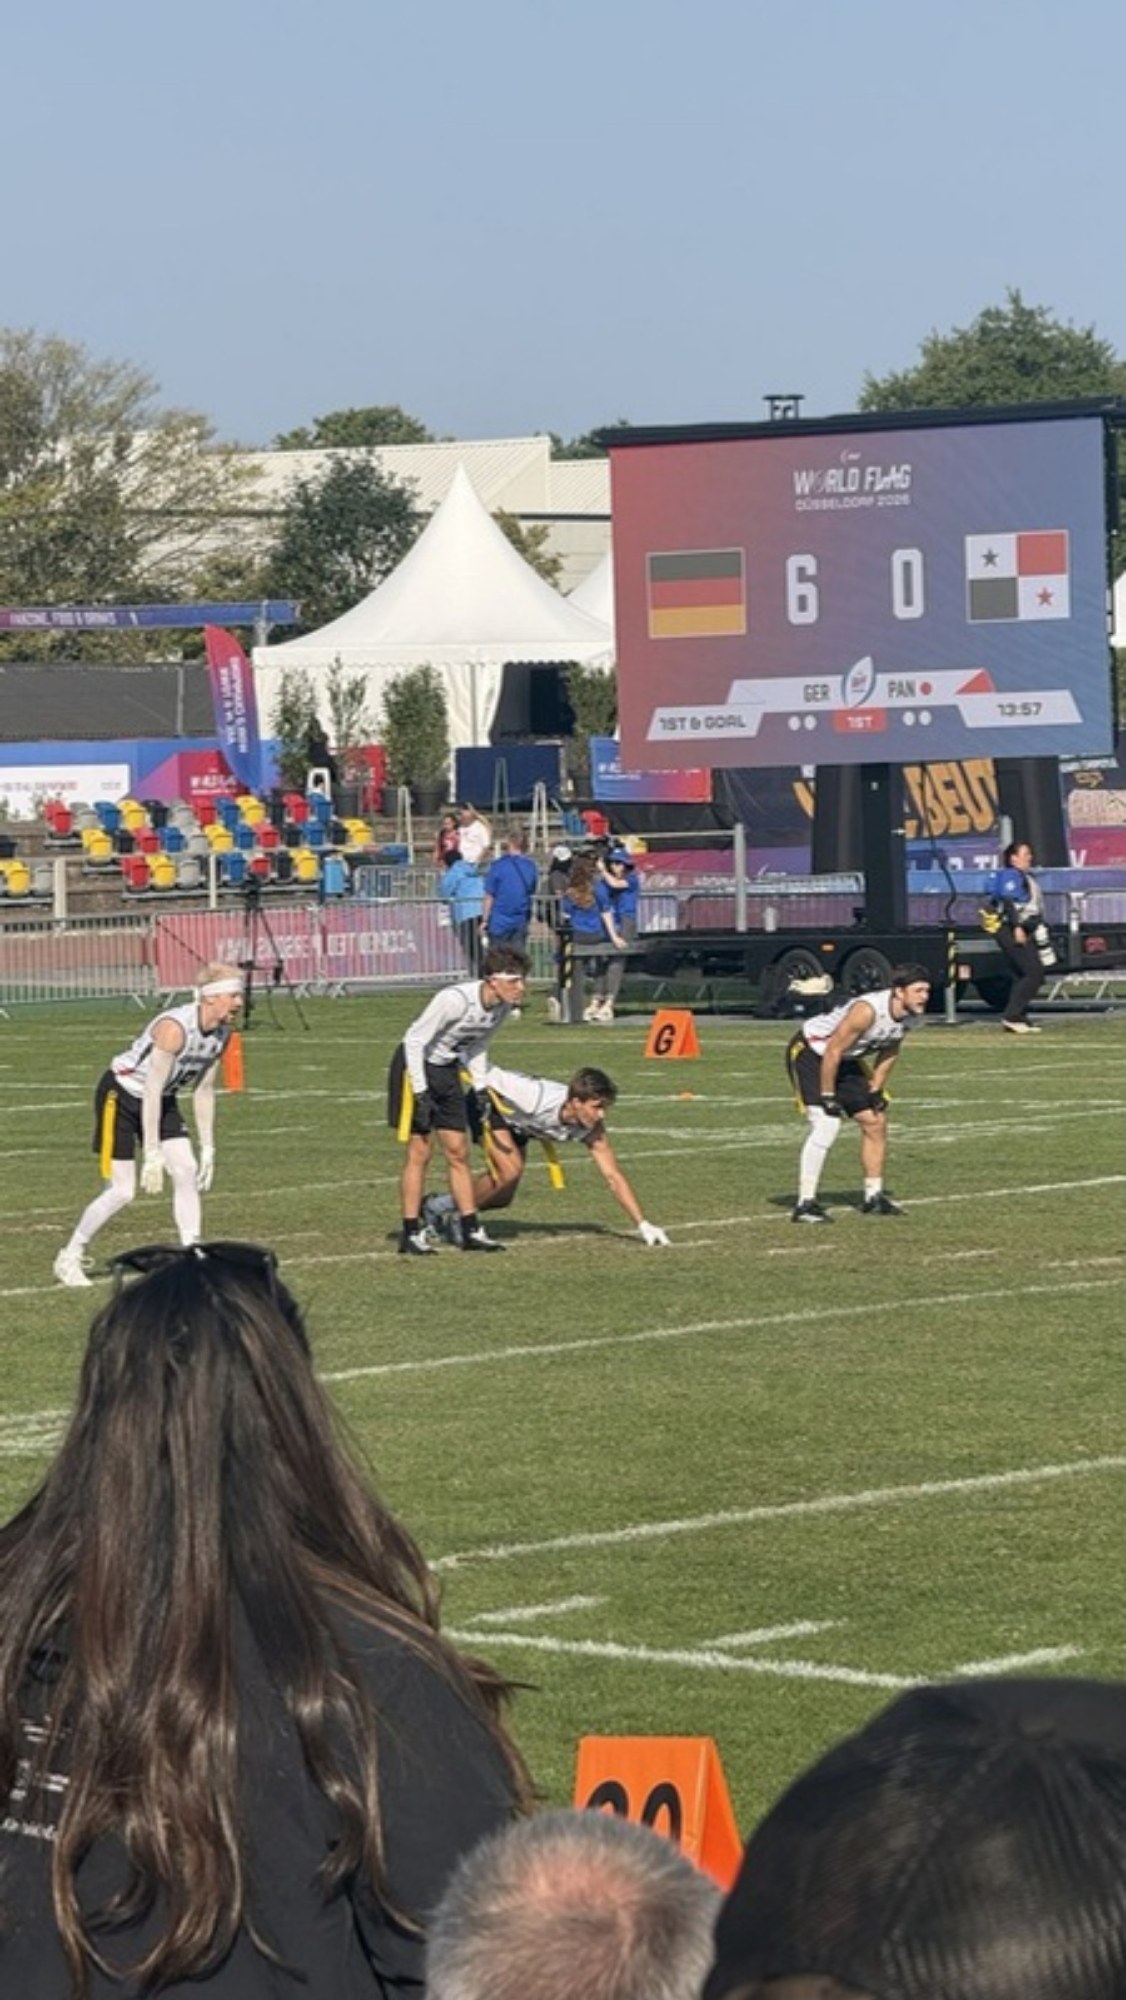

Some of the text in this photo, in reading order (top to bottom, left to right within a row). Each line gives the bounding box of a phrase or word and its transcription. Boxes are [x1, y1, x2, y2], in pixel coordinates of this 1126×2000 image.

[793, 464, 911, 495] WORLD FLAG
[786, 548, 925, 626] 6 0
[803, 683, 830, 702] GER
[888, 680, 916, 698] PAN
[997, 702, 1043, 717] 13:57
[660, 715, 747, 731] 1ST & GOAL
[846, 716, 874, 729] 1ST
[654, 1023, 676, 1056] G
